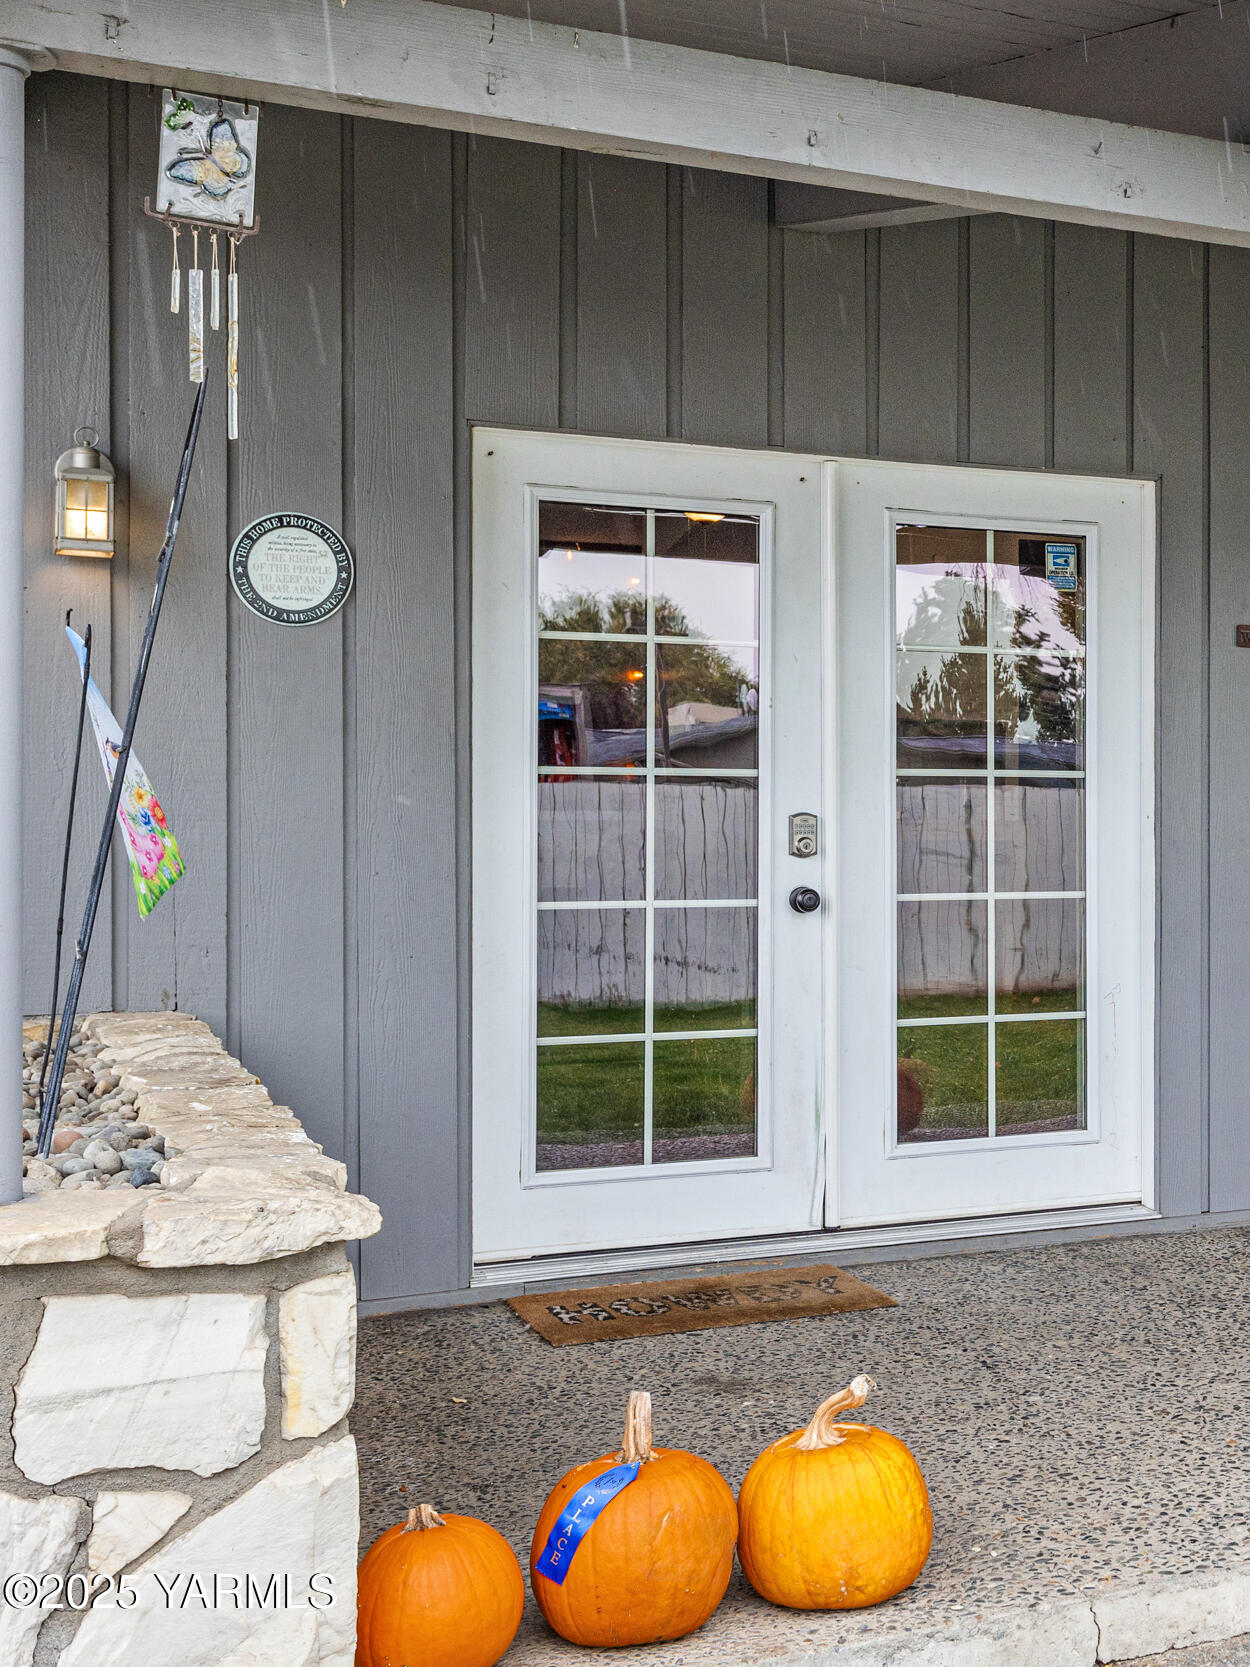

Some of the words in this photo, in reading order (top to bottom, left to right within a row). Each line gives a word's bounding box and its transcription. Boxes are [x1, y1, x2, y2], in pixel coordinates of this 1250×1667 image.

[235, 537, 253, 563] THIS
[249, 517, 281, 541] HOME
[282, 516, 343, 552] PROTECTED
[336, 553, 349, 568] BY
[292, 564, 332, 575] PEOPLE
[304, 575, 326, 585] AND
[238, 577, 256, 600] THE
[255, 599, 277, 617] 2ND
[280, 583, 347, 622] AMENDMENT
[546, 1275, 846, 1327] HOWDY
[550, 1495, 595, 1566] PLACE
